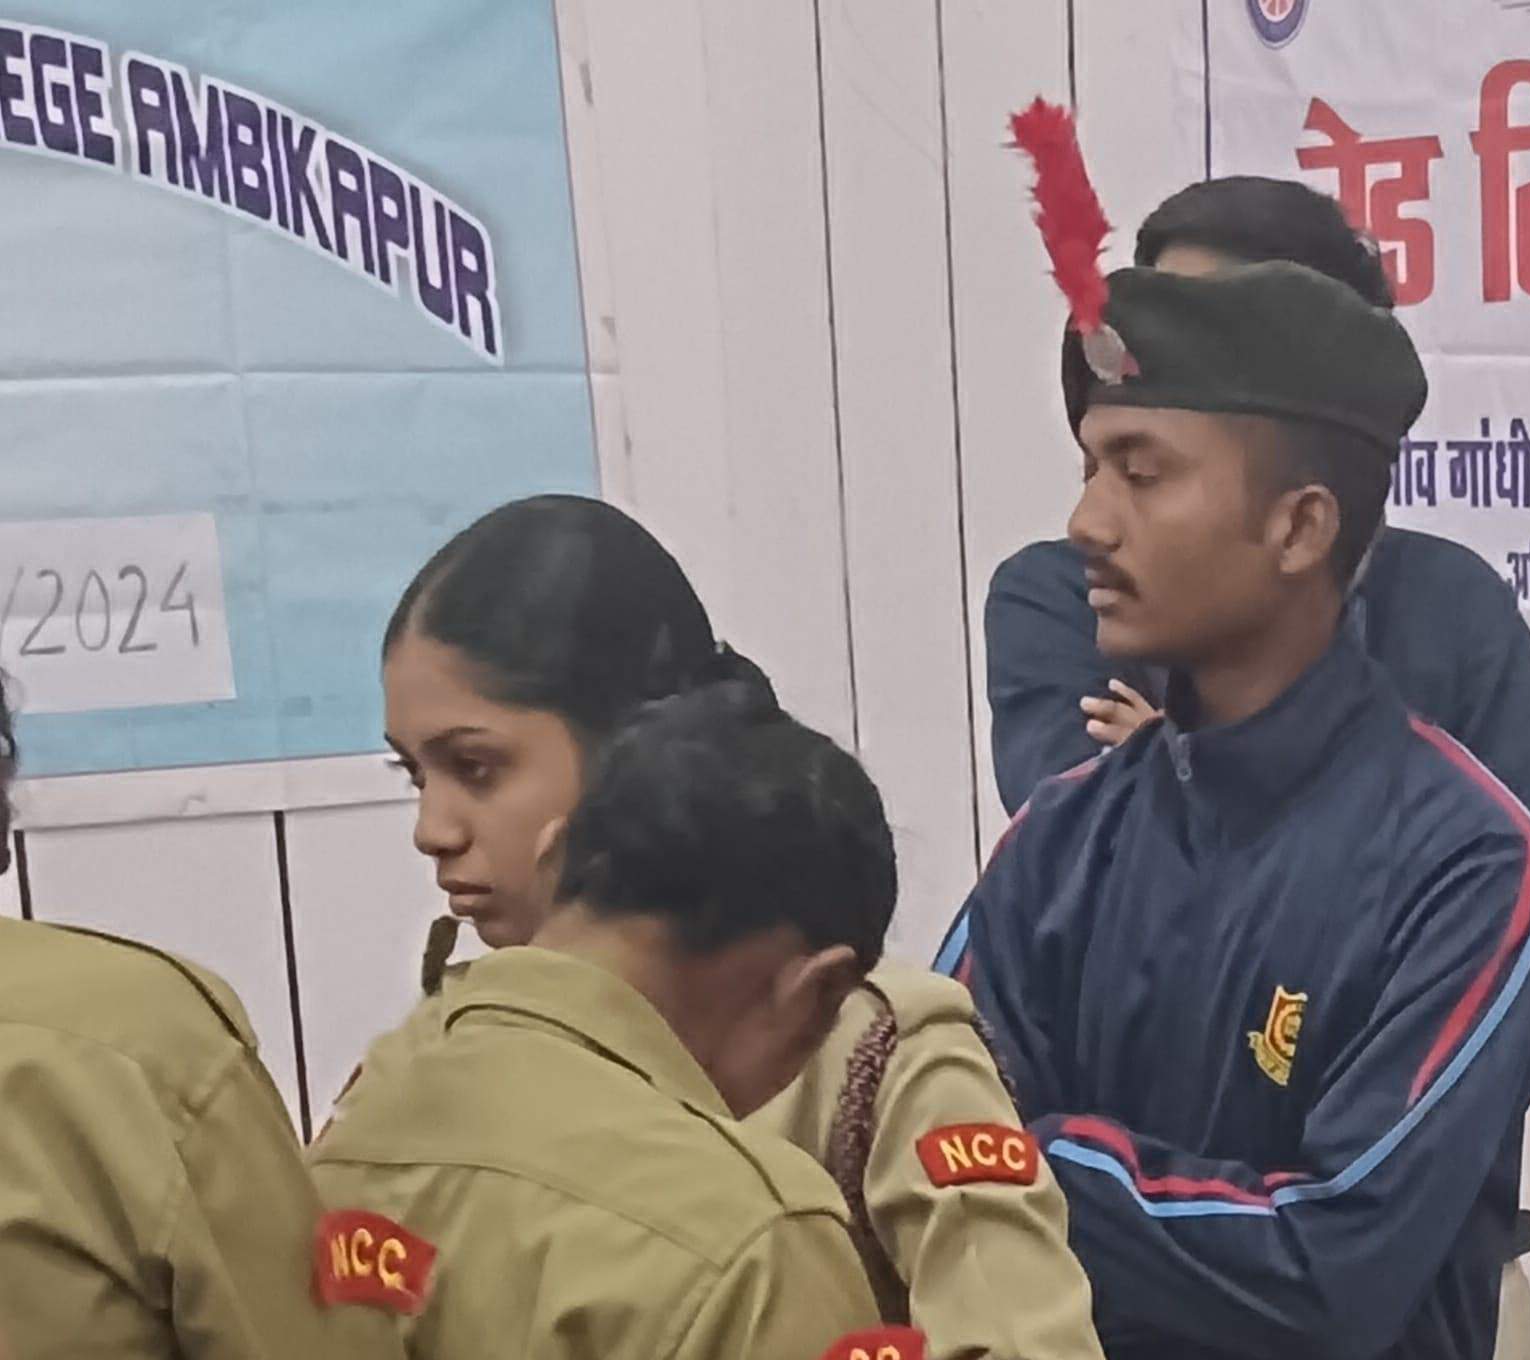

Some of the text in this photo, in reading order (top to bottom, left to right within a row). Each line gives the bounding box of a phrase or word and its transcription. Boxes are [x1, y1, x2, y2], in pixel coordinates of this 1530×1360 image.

[0, 27, 496, 357] EGE AMBIKAPUR
[939, 1132, 1027, 1174] NCC
[330, 1227, 408, 1290] NCC
